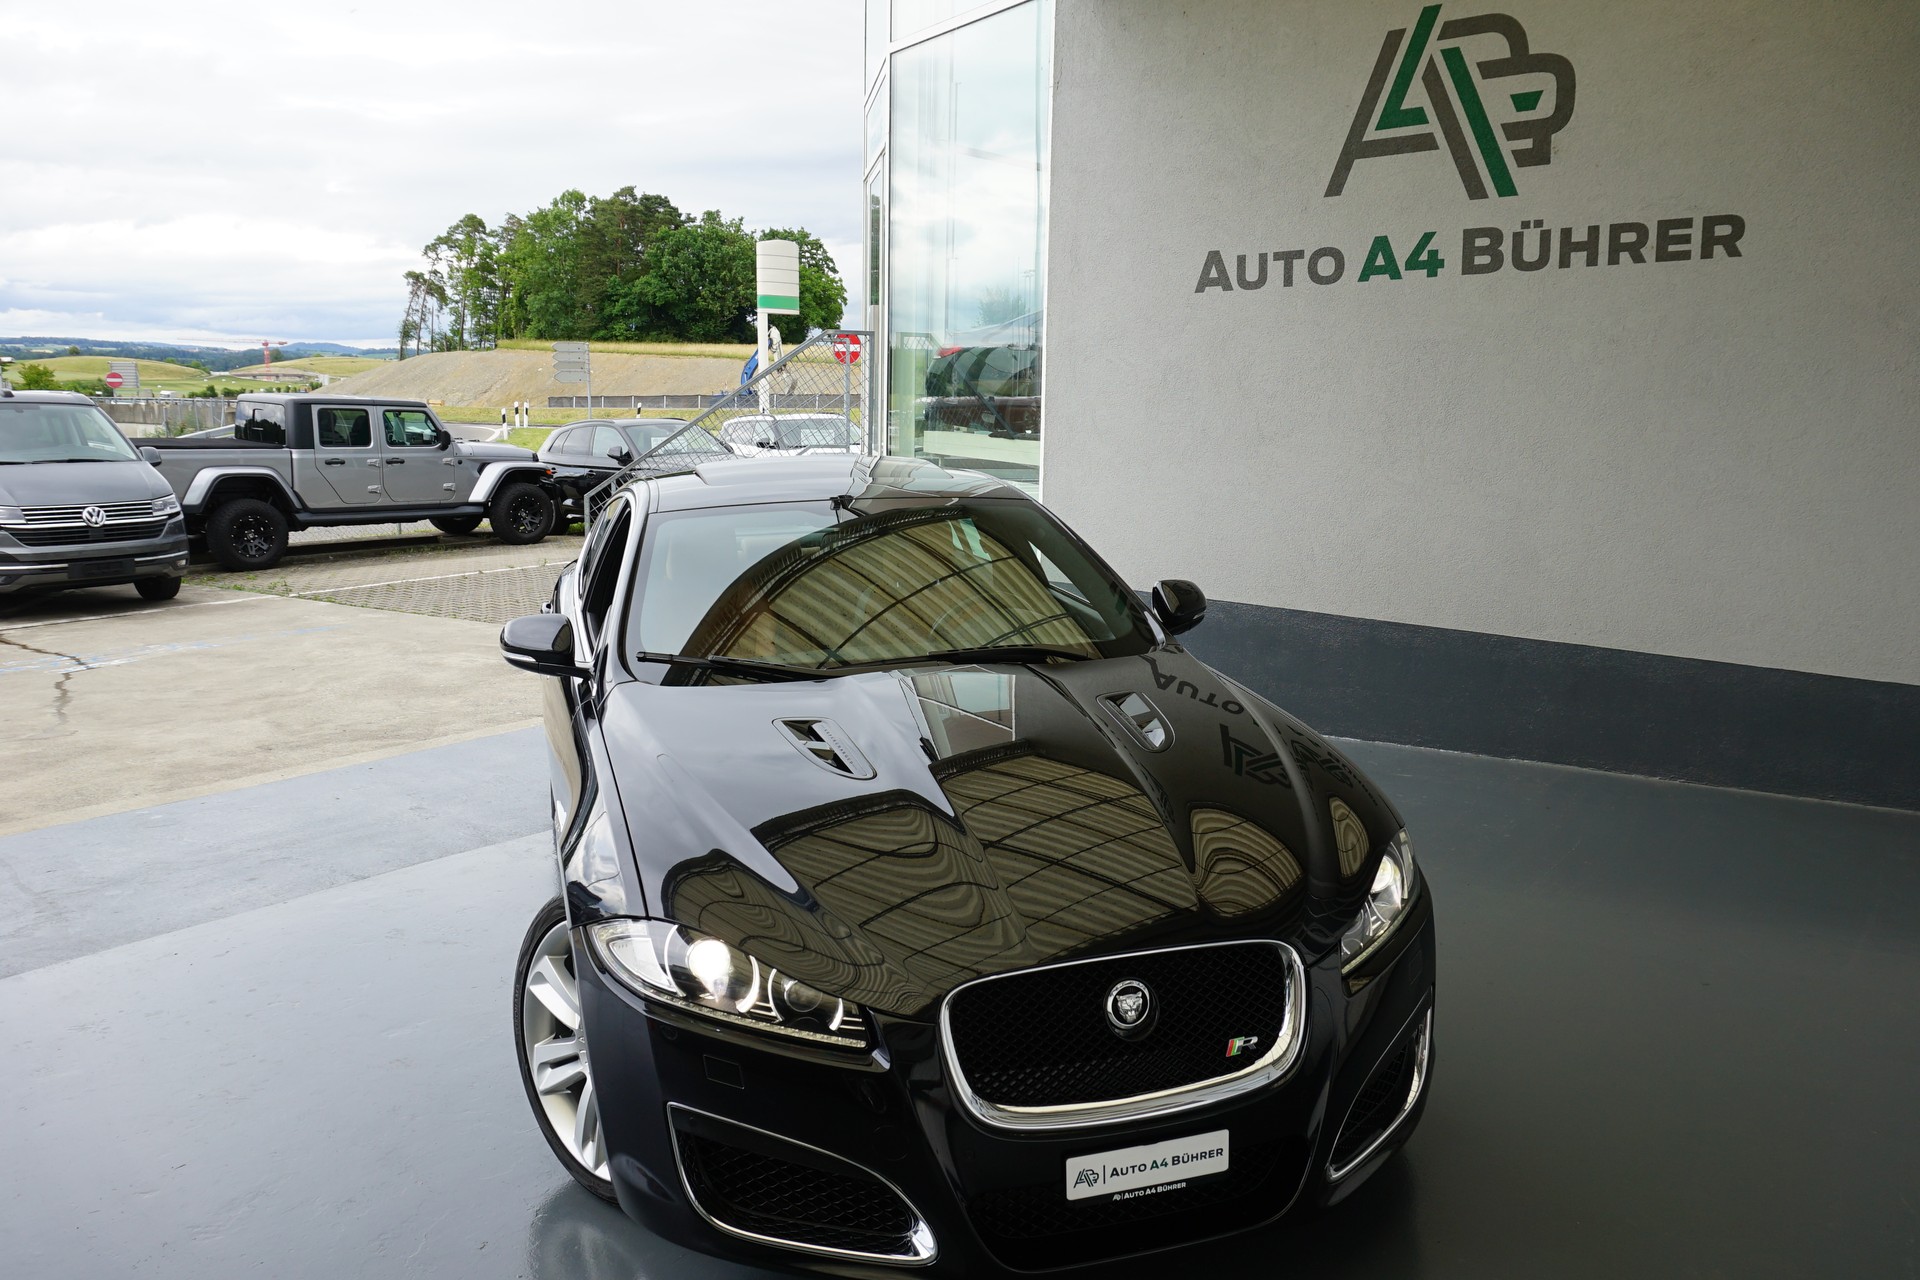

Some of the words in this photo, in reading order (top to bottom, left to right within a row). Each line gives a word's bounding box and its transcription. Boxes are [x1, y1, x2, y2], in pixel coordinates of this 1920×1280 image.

[1195, 247, 1345, 293] AUTO
[1357, 231, 1445, 282] A4
[1461, 214, 1746, 275] BÜHRER
[1110, 1163, 1147, 1178] AUTO
[1149, 1158, 1168, 1170] A4
[1171, 1148, 1224, 1166] BÜHRER
[1124, 1190, 1144, 1199] AUTO
[1145, 1187, 1156, 1195] A4
